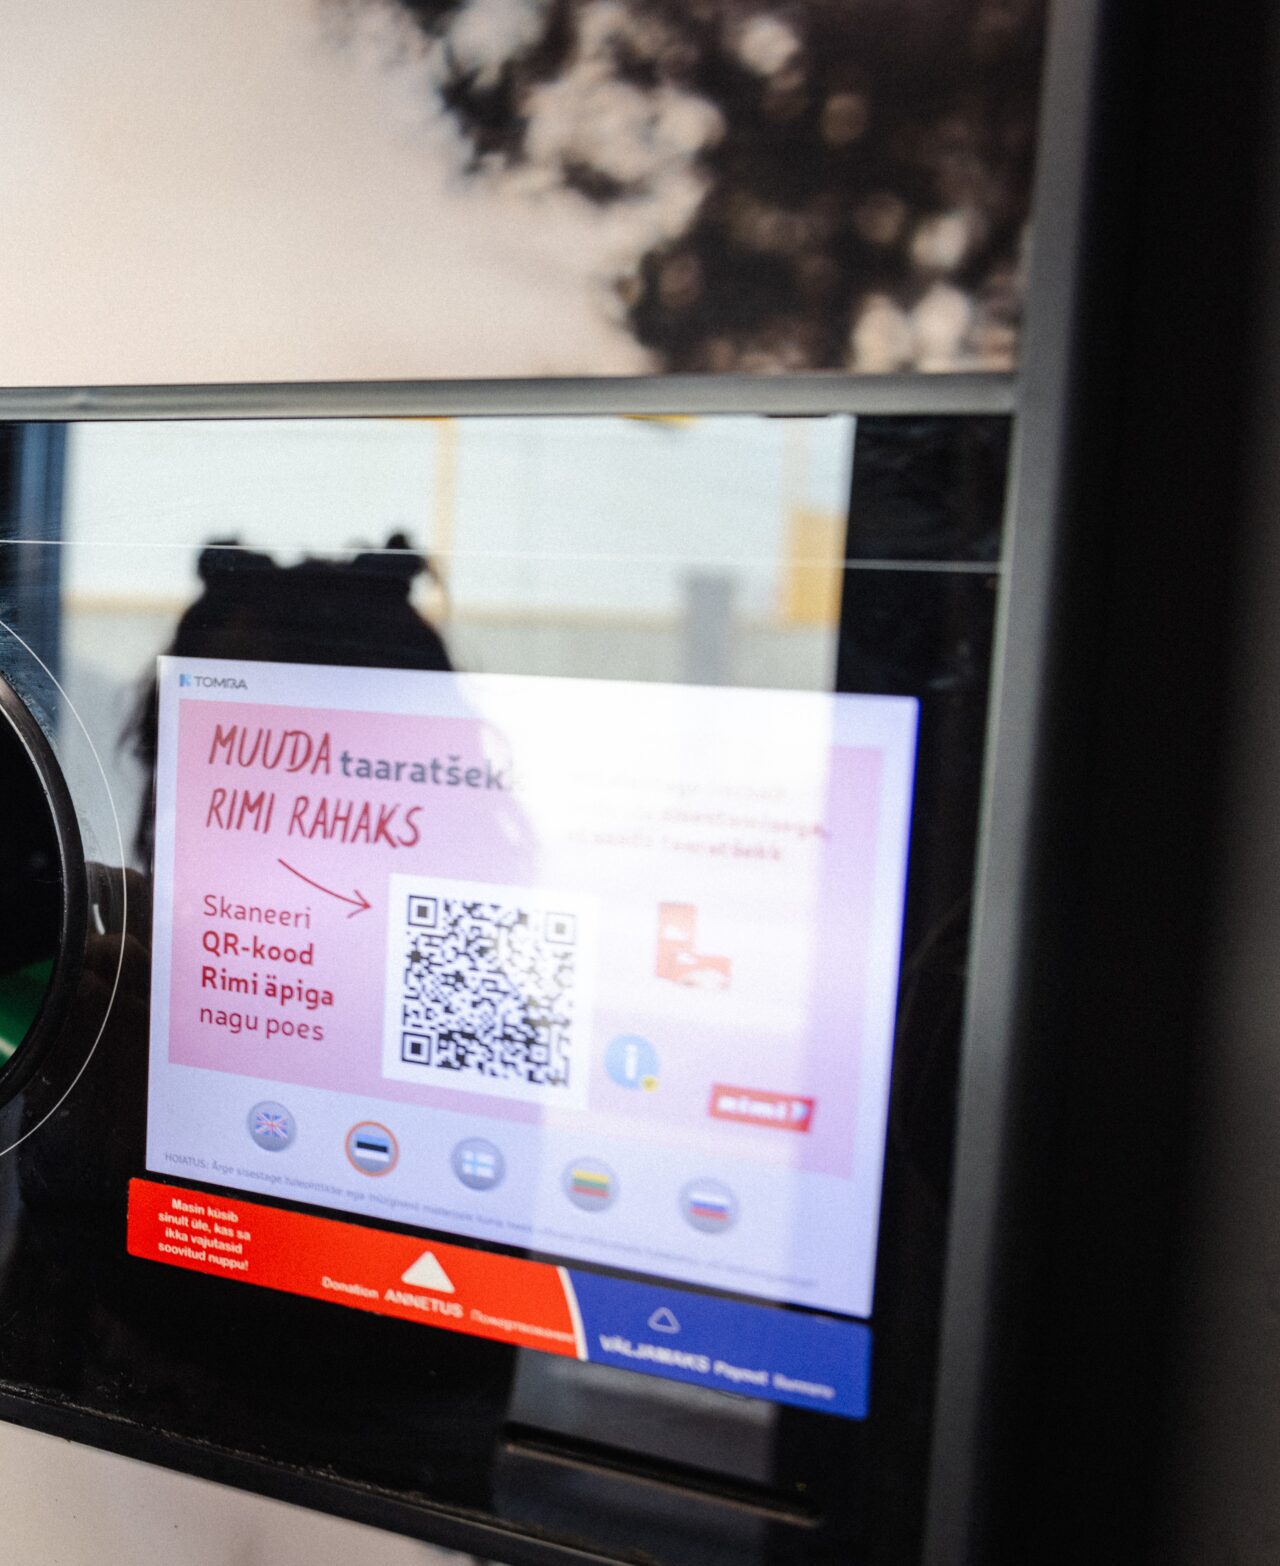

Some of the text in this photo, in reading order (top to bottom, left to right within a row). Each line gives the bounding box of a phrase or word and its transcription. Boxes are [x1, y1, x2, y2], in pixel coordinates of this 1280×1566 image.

[207, 723, 332, 776] MUUDA
[340, 750, 520, 791] taaratšek
[205, 787, 424, 849] RIMI RAHAKS
[202, 894, 312, 929] Skaneeri
[201, 929, 314, 966] QR-kood
[201, 965, 335, 1011] Rimi äpiga
[199, 1006, 324, 1041] nagu poes
[158, 1212, 251, 1242] sinult üle, kas sa
[171, 1198, 239, 1223] Masin küsib
[158, 1242, 249, 1271] soovitud nuppu!
[165, 1227, 243, 1255] ikka vajutasid
[321, 1275, 464, 1319] Donation ANNETUS
[598, 1334, 711, 1374] VÄLJAMAKS
